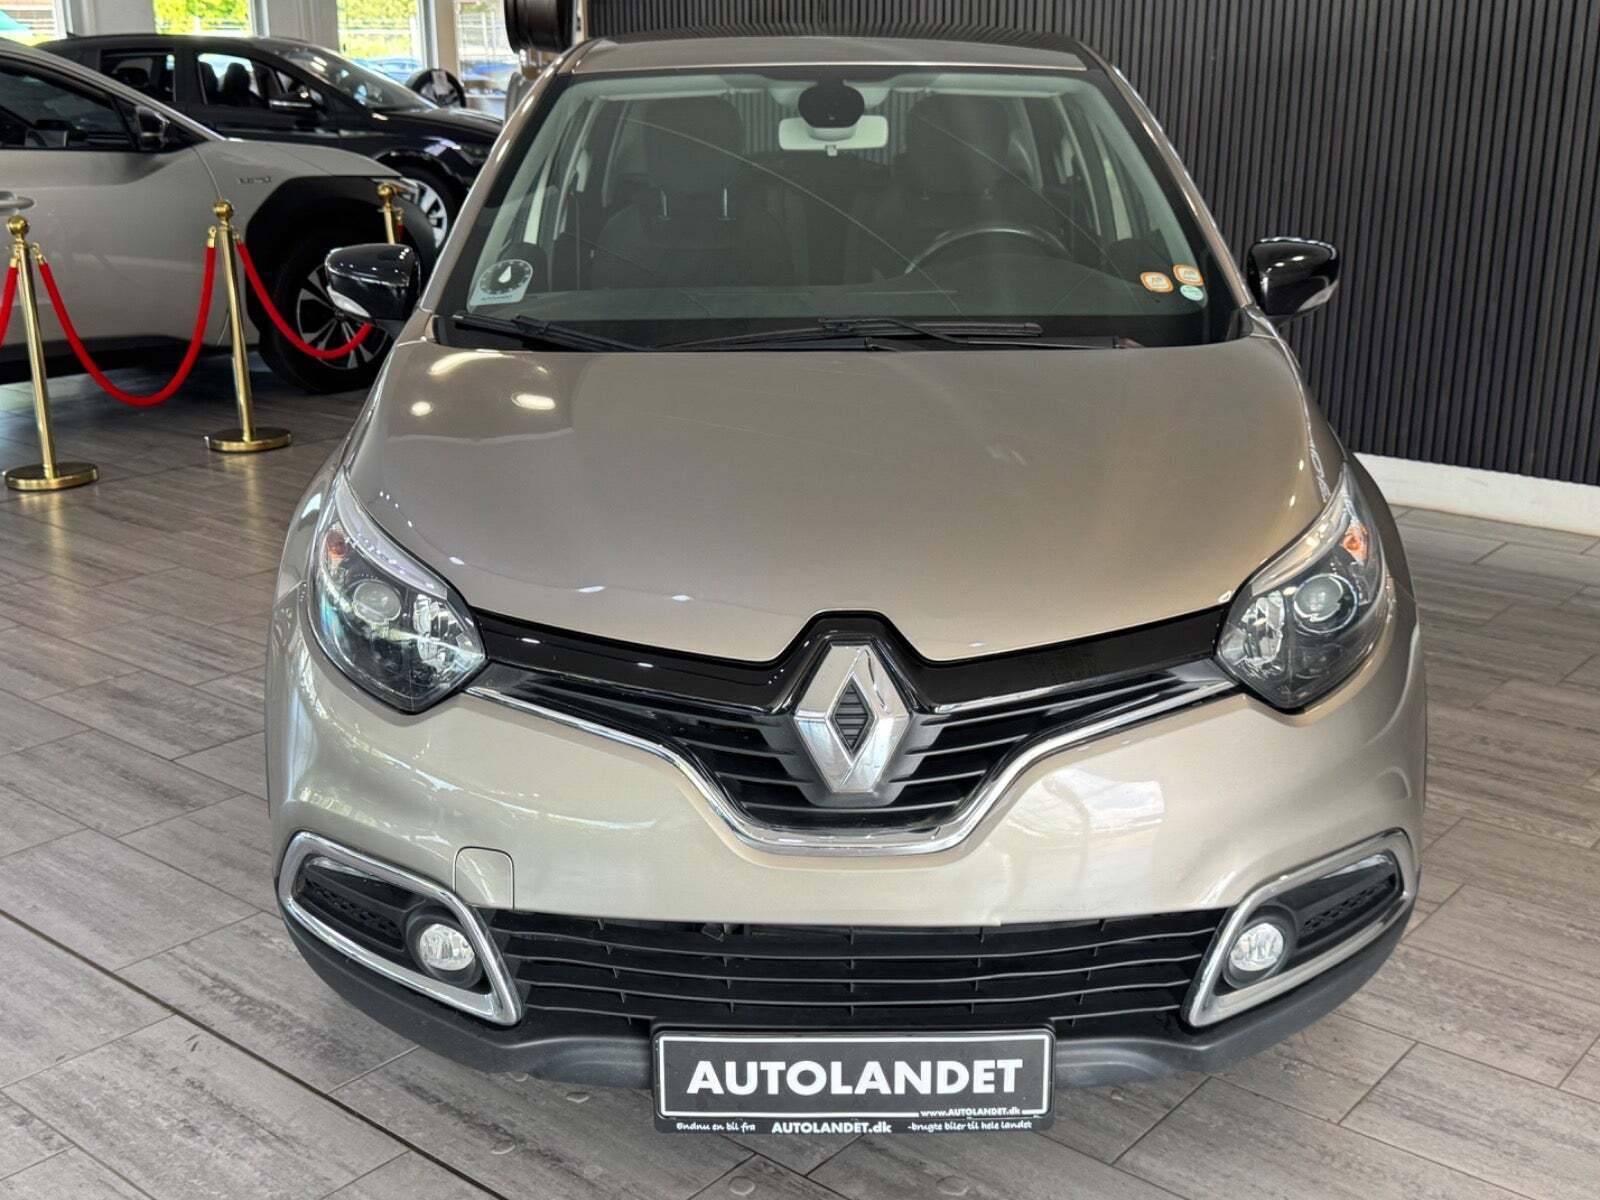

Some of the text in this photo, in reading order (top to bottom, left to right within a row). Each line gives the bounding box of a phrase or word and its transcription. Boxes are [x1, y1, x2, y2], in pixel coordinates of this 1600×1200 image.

[686, 1058, 1024, 1095] AUTOLANDET
[920, 1106, 1021, 1117] www.AUTOLANDET.dk
[771, 1120, 893, 1134] AUTOLANDET.dk
[966, 1120, 979, 1131] til
[981, 1120, 998, 1130] hele
[1000, 1119, 1032, 1130] landet
